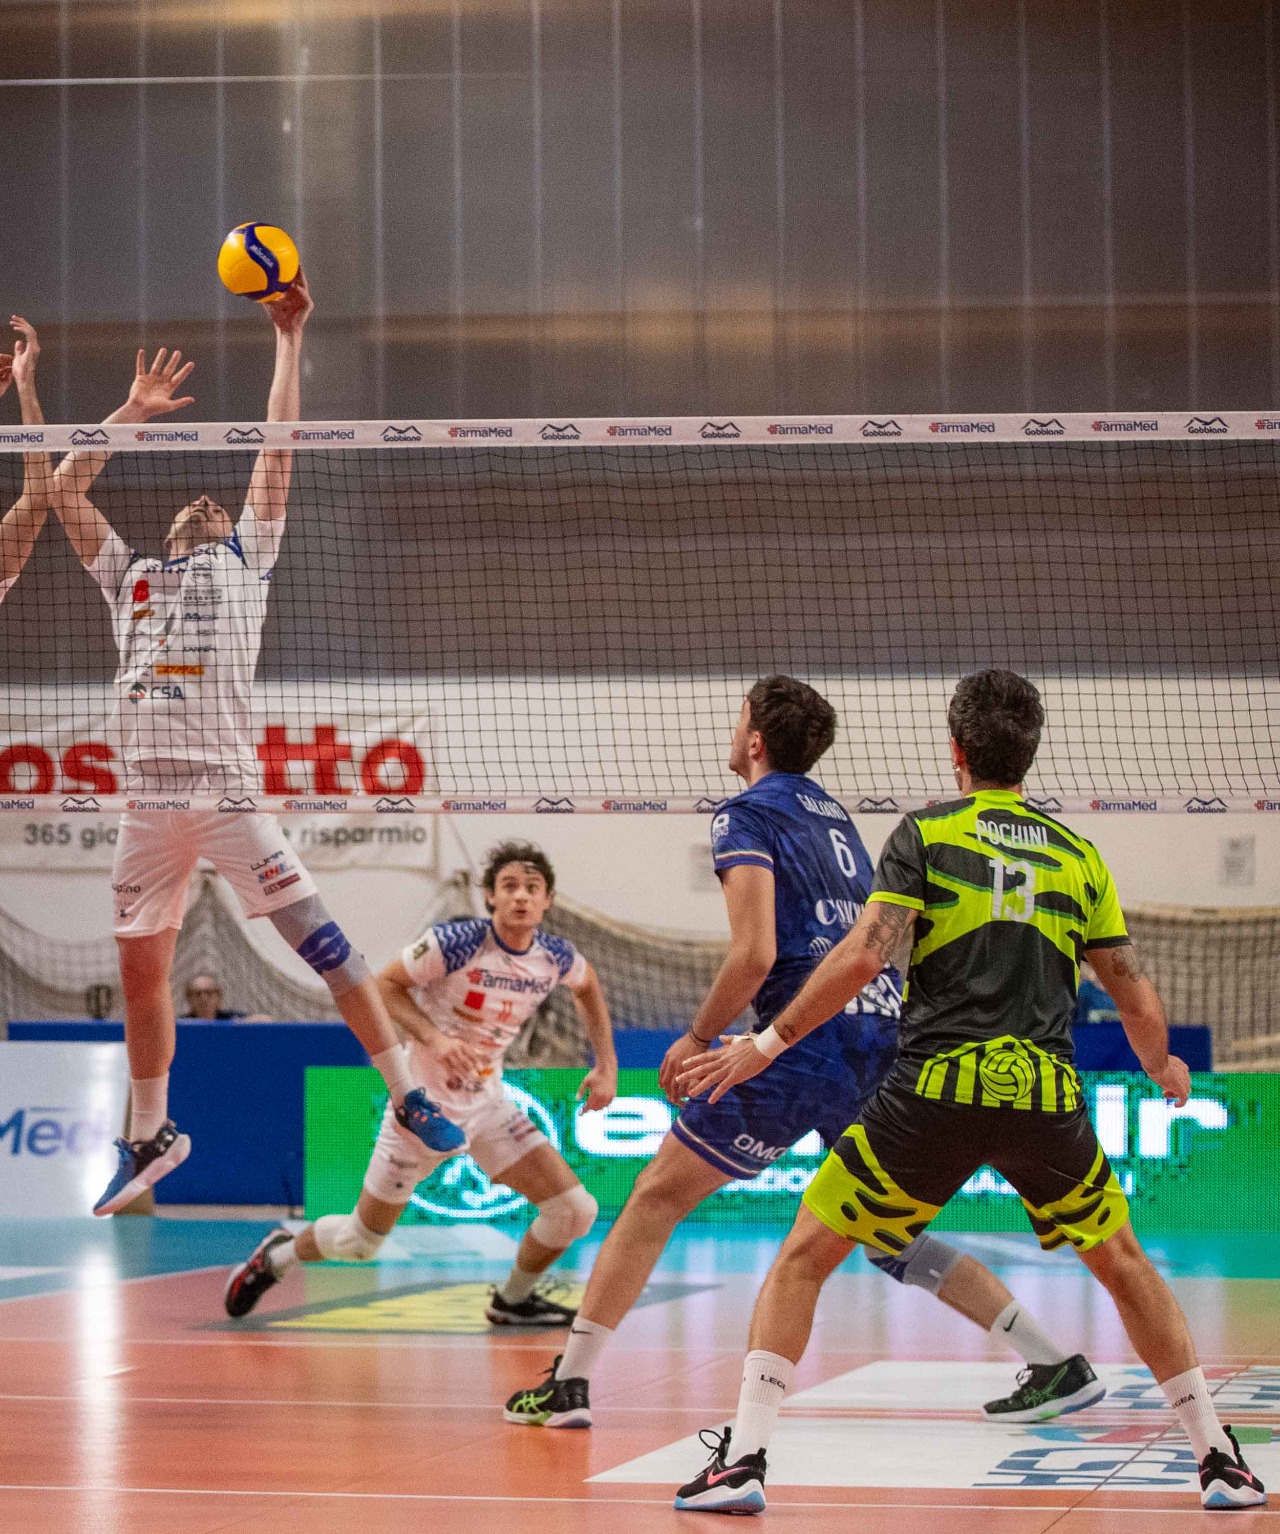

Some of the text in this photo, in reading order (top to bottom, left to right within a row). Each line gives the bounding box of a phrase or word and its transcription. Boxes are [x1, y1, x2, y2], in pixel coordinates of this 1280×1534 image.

[606, 425, 672, 437] FarmaMed
[767, 423, 833, 435] FarmaMed
[928, 422, 995, 434] FarmaMed
[1025, 427, 1064, 436] Gabbiano
[1091, 420, 1158, 432] FarmaMed
[1188, 426, 1228, 435] Gabbiano
[135, 430, 198, 442] FarmaMed
[290, 428, 355, 440] FarmaMed
[448, 426, 513, 438] FarmaMed
[541, 432, 580, 440] Gabbiano
[701, 430, 740, 439] Gabbiano
[862, 428, 902, 437] Gabbiano
[71, 437, 109, 446] Gabbiano
[226, 436, 265, 444] Gabbiano
[383, 434, 421, 442] Gabbiano
[151, 686, 185, 700] CSA
[62, 805, 100, 813] Gabbiano
[126, 799, 190, 810] FarmaMed
[218, 805, 256, 813] Gabbiano
[282, 799, 347, 811] FarmaMed
[376, 805, 414, 813] Gabbiano
[441, 800, 506, 811] FarmaMed
[601, 800, 667, 811] FarmaMed
[860, 806, 898, 814] Gabbiano
[1090, 800, 1157, 812] FarmaMed
[1187, 805, 1227, 814] Gabbiano
[23, 823, 71, 846] 365
[300, 823, 426, 849] risparmio
[976, 820, 1048, 848] POCHINI
[829, 828, 857, 878] 6
[989, 857, 1036, 922] 13
[467, 967, 551, 999] FarmaMed
